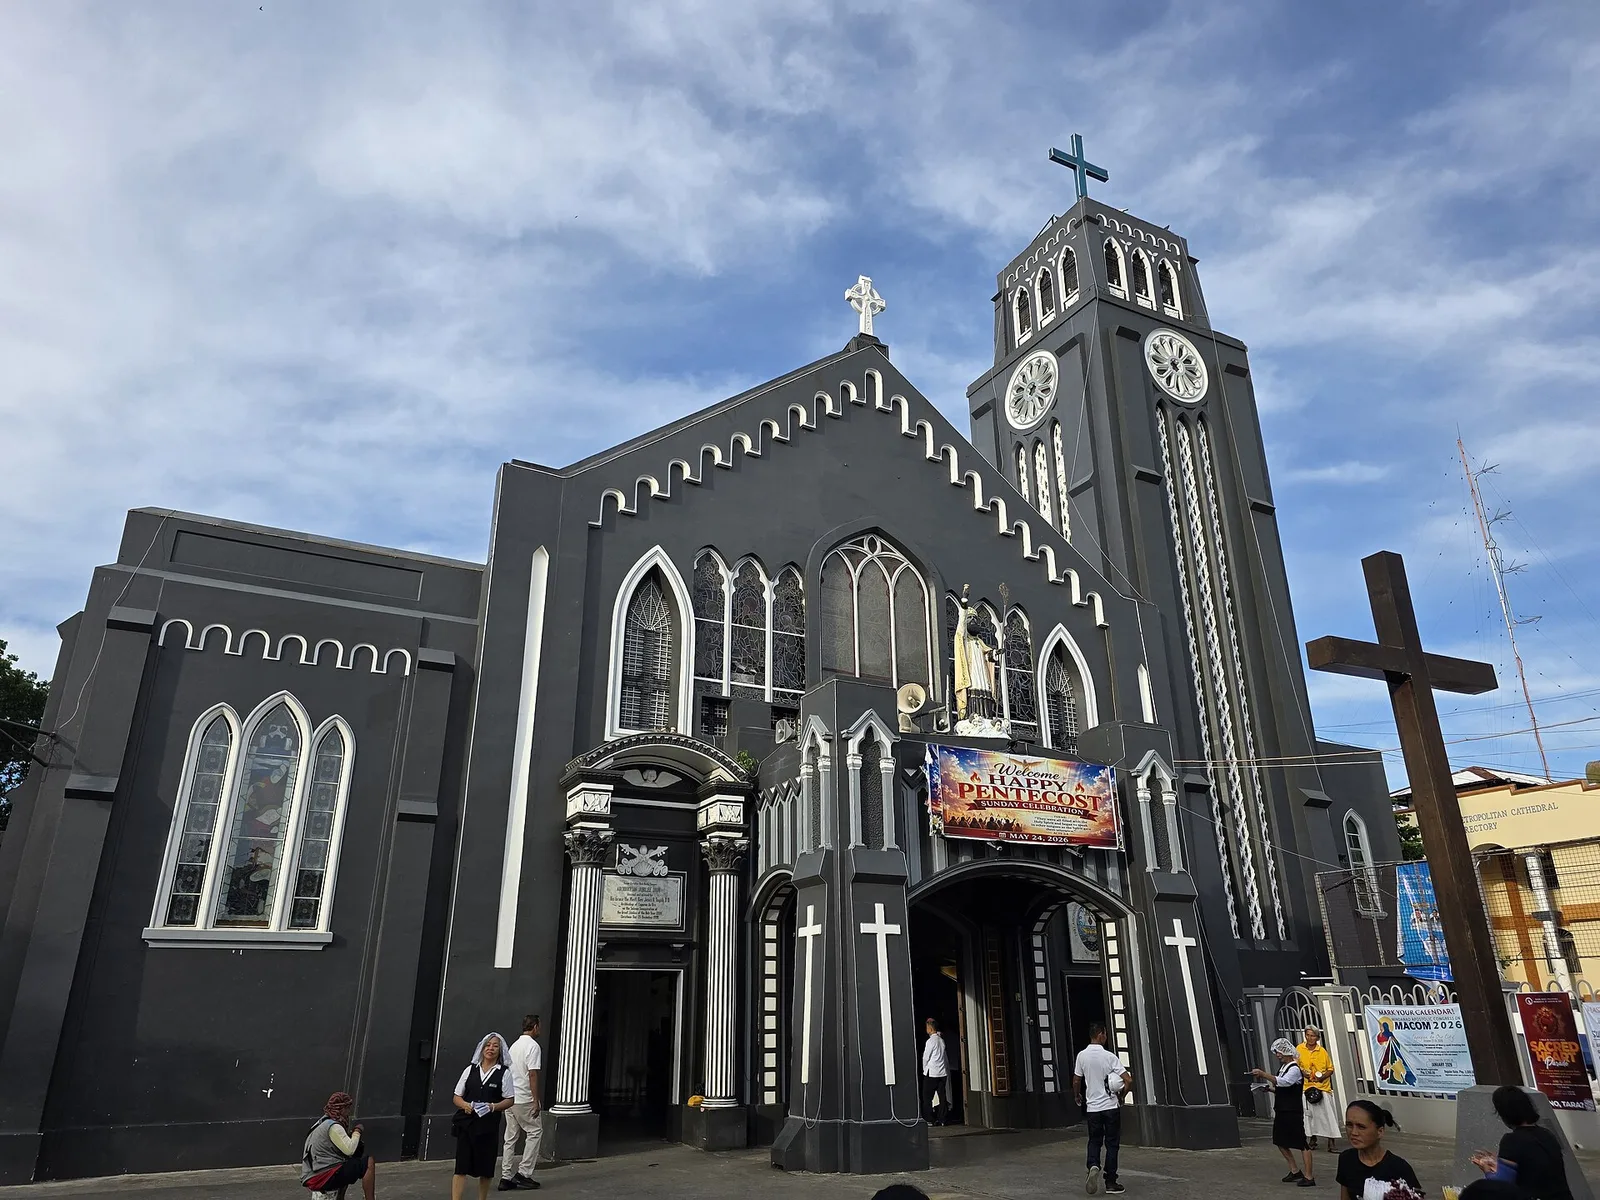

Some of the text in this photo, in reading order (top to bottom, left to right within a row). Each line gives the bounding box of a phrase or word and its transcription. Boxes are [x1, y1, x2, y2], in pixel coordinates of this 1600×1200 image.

[994, 763, 1060, 780] Welcome
[988, 774, 1067, 791] HAPPY
[958, 782, 1102, 811] PENTECOST
[980, 800, 1084, 815] SUNDAY CELEBRATION
[1463, 802, 1559, 823] TROPOLITAN CATHEDRAL
[1009, 832, 1030, 840] MAY
[1414, 1008, 1455, 1016] CALENDAR!
[1394, 1020, 1463, 1030] MACOM 2026
[1529, 1041, 1579, 1053] SACRED
[1536, 1050, 1576, 1063] HEART
[1549, 1100, 1562, 1108] NO,
